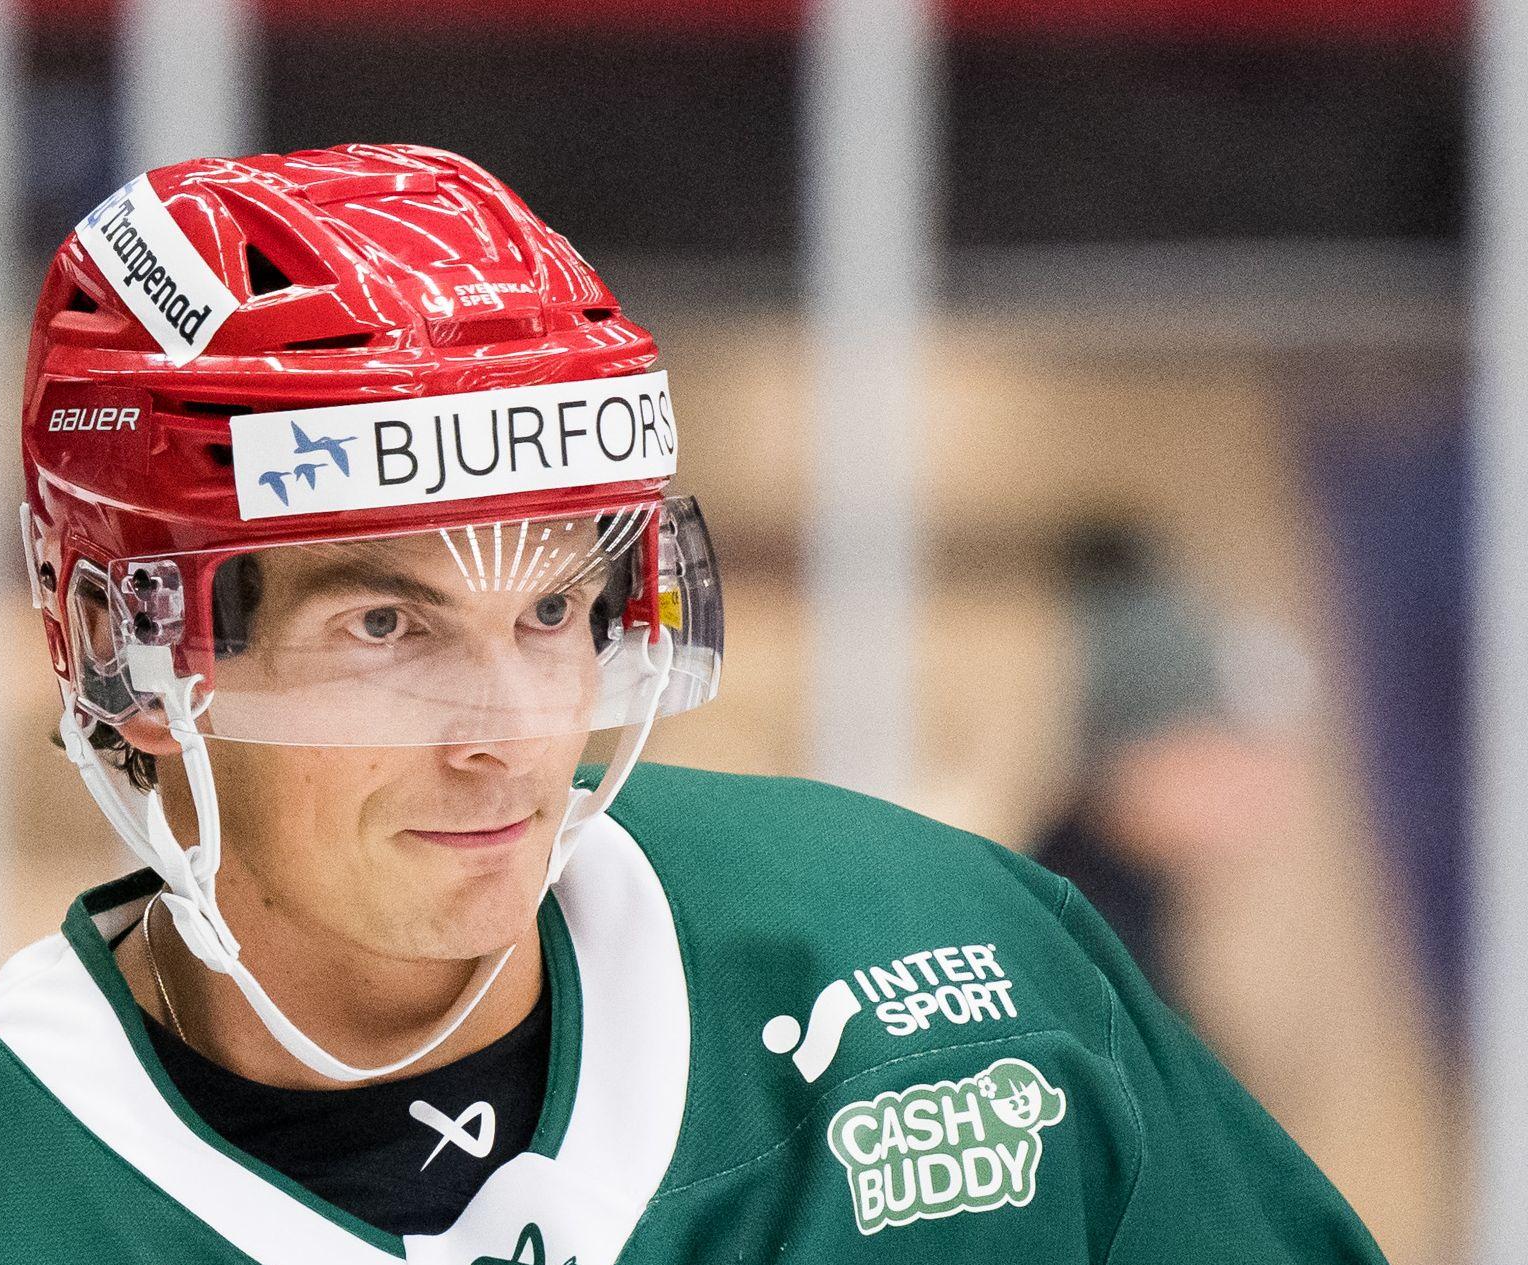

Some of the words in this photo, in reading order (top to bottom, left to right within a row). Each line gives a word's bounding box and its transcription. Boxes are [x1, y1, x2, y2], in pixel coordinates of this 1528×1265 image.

[100, 199, 212, 346] Tranpenad
[374, 390, 674, 493] BJURFORS
[854, 944, 1005, 1002] INTER
[877, 980, 1018, 1036] SPORT
[842, 1092, 985, 1165] CASH
[858, 1140, 1029, 1221] BUDDY
